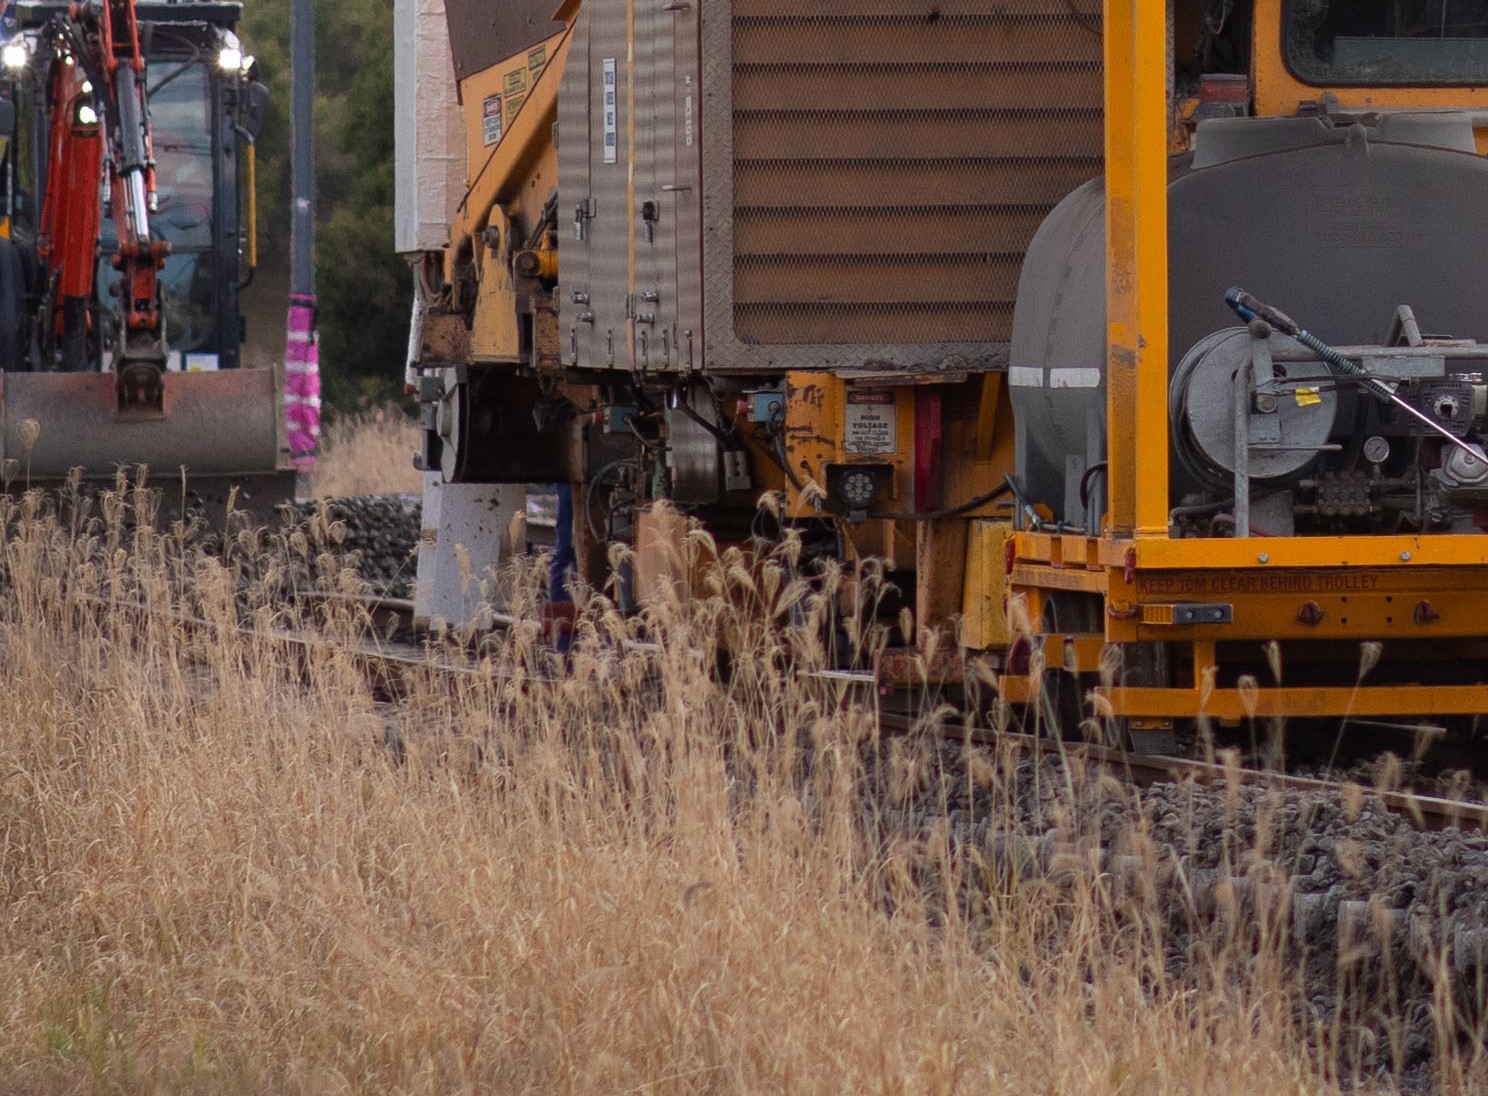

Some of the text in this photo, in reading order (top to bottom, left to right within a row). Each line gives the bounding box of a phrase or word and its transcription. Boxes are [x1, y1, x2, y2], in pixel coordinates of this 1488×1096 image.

[1140, 578, 1174, 592] KEEP
[1212, 575, 1256, 591] CLEAR
[1262, 575, 1311, 591] BEHIND
[1317, 574, 1379, 591] TROLLEY
